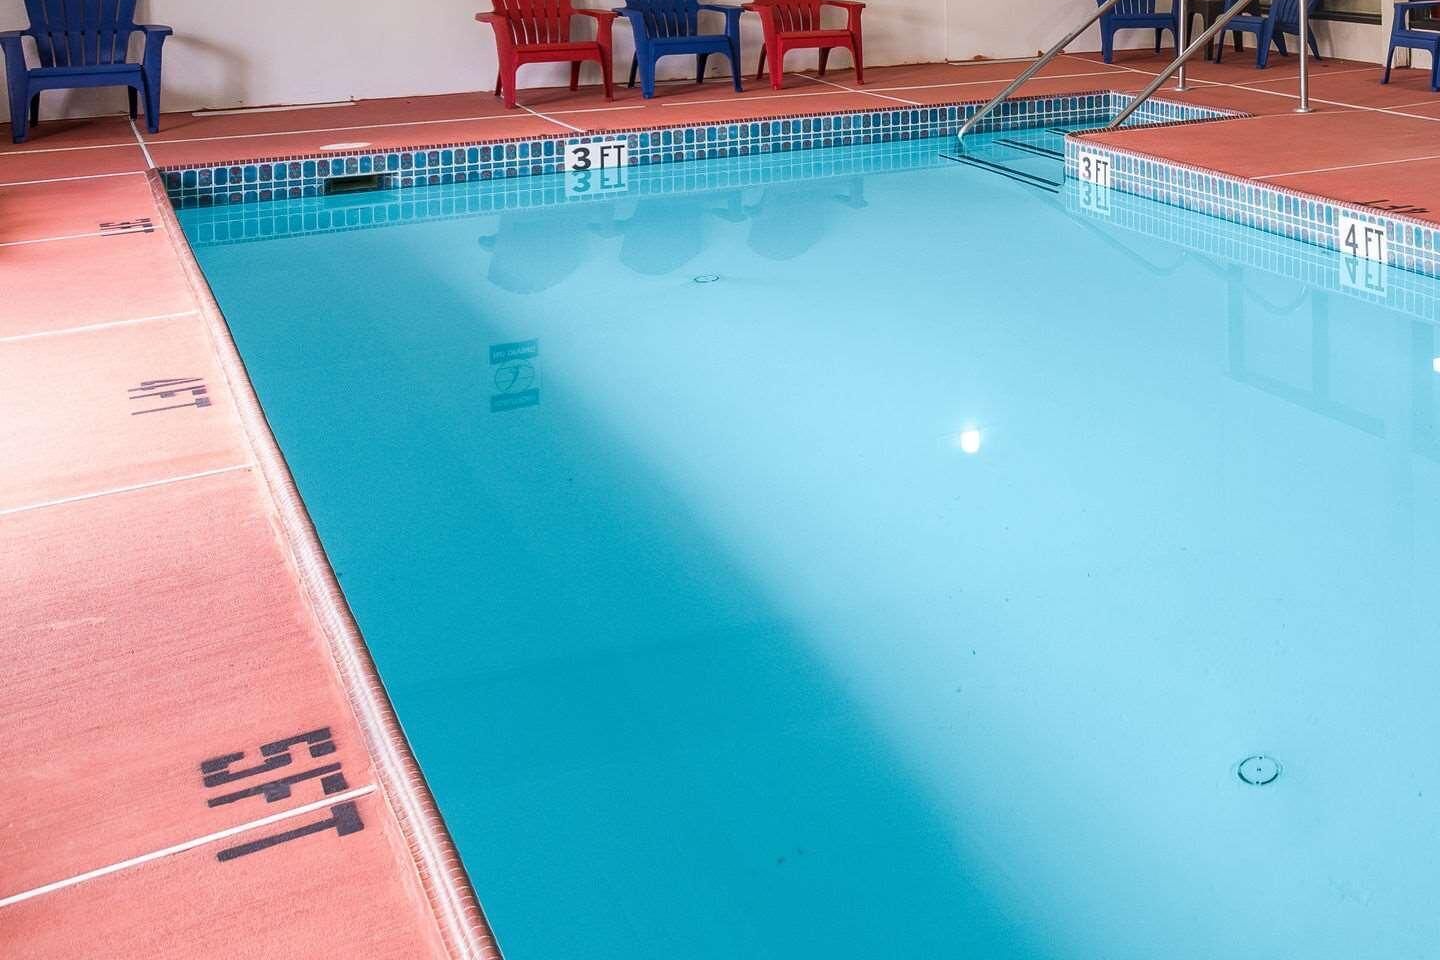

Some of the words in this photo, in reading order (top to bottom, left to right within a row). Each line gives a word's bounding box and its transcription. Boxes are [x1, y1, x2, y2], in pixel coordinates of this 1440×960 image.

[572, 147, 592, 170] 3
[600, 145, 625, 169] FT
[1082, 156, 1092, 180] 3
[1095, 159, 1108, 188] FT
[1345, 223, 1358, 257] 4
[1364, 227, 1384, 264] FT
